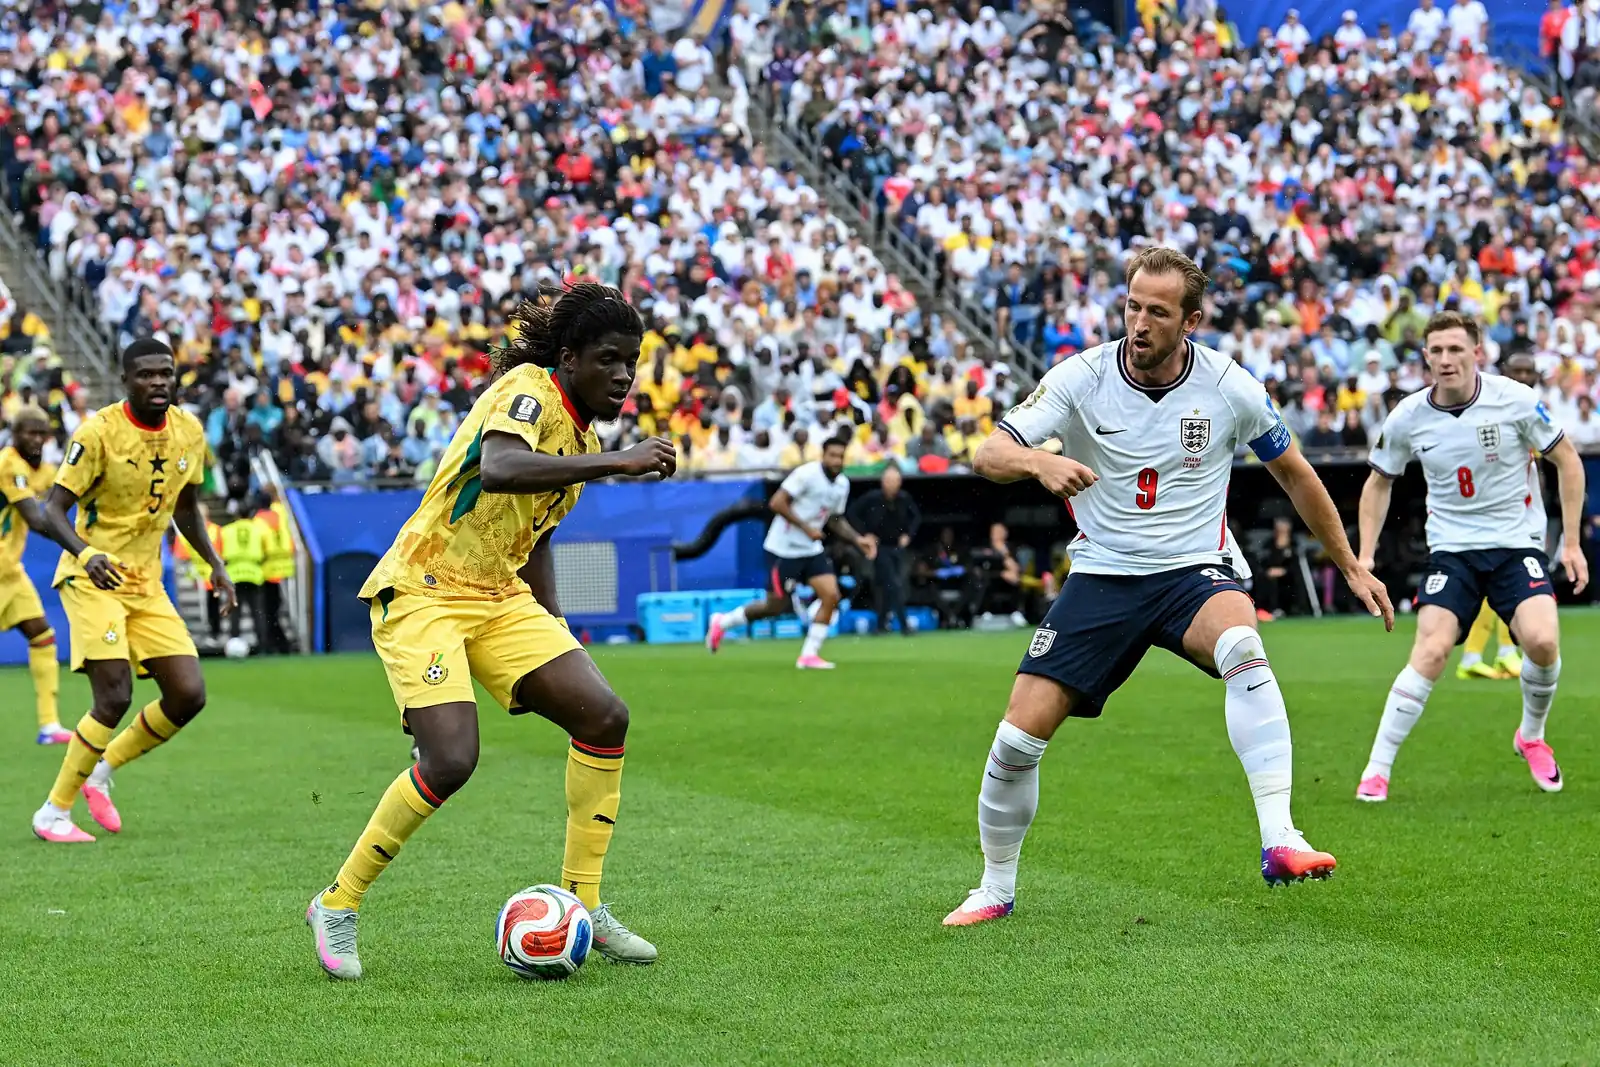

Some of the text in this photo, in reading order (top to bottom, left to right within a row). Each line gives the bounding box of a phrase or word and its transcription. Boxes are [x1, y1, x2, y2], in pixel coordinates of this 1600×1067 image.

[148, 479, 164, 514] 5
[1136, 467, 1159, 510] 9
[1457, 466, 1475, 498] 8
[1523, 556, 1544, 578] 8
